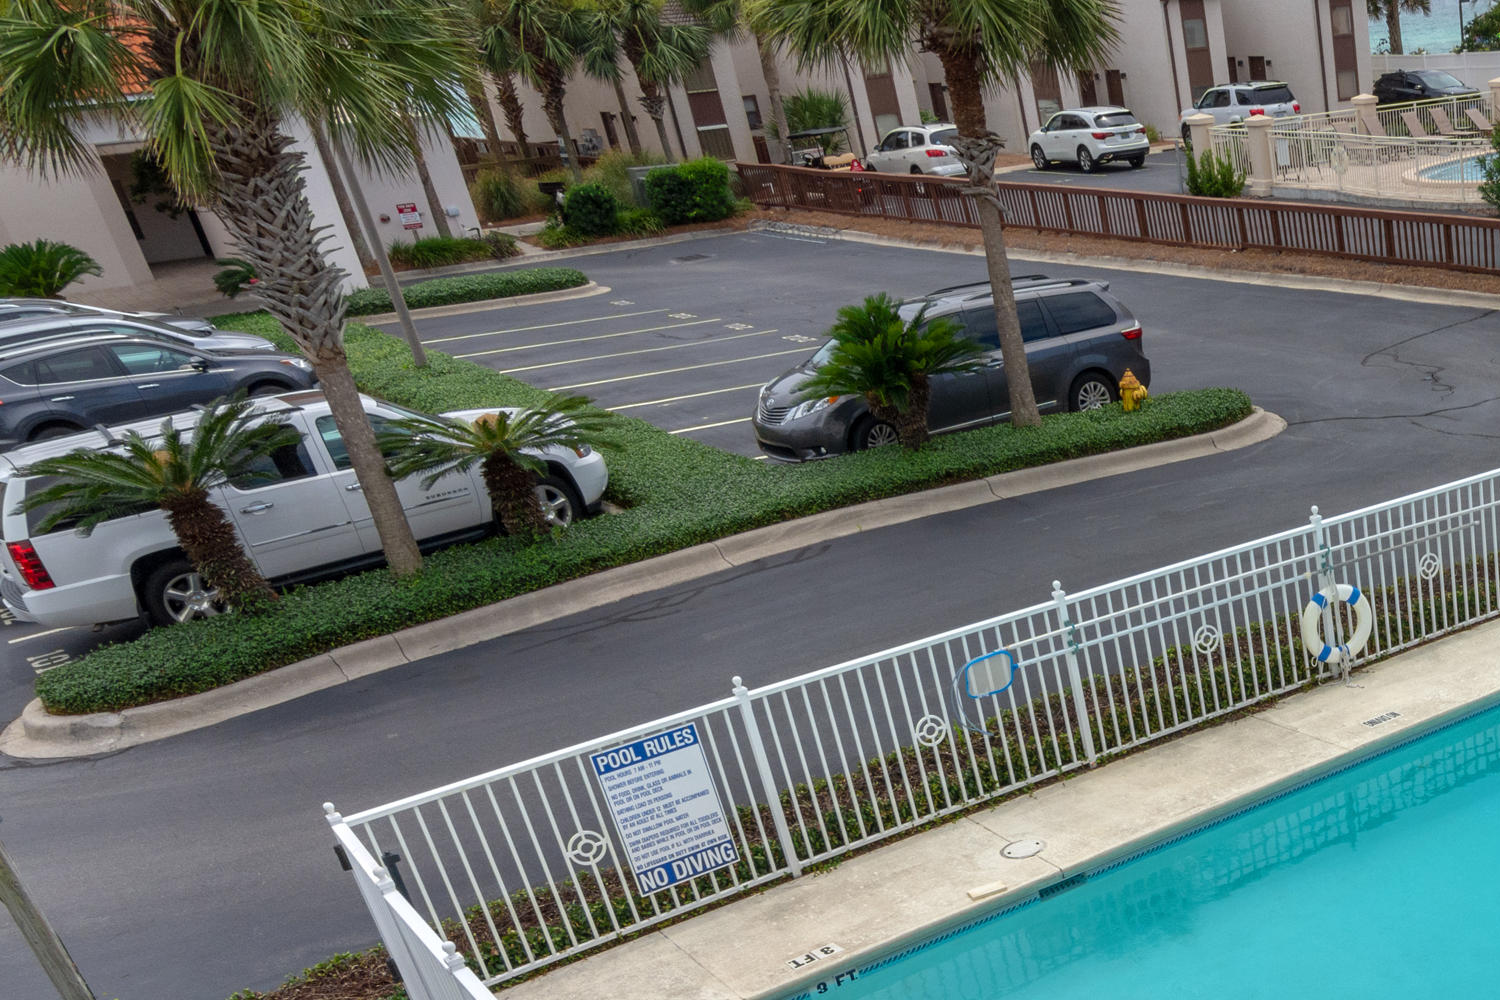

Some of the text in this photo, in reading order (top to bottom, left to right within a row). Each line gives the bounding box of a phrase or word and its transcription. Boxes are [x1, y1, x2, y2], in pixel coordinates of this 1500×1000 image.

[597, 729, 694, 772] POOL RULES
[639, 843, 735, 892] NO DIVING
